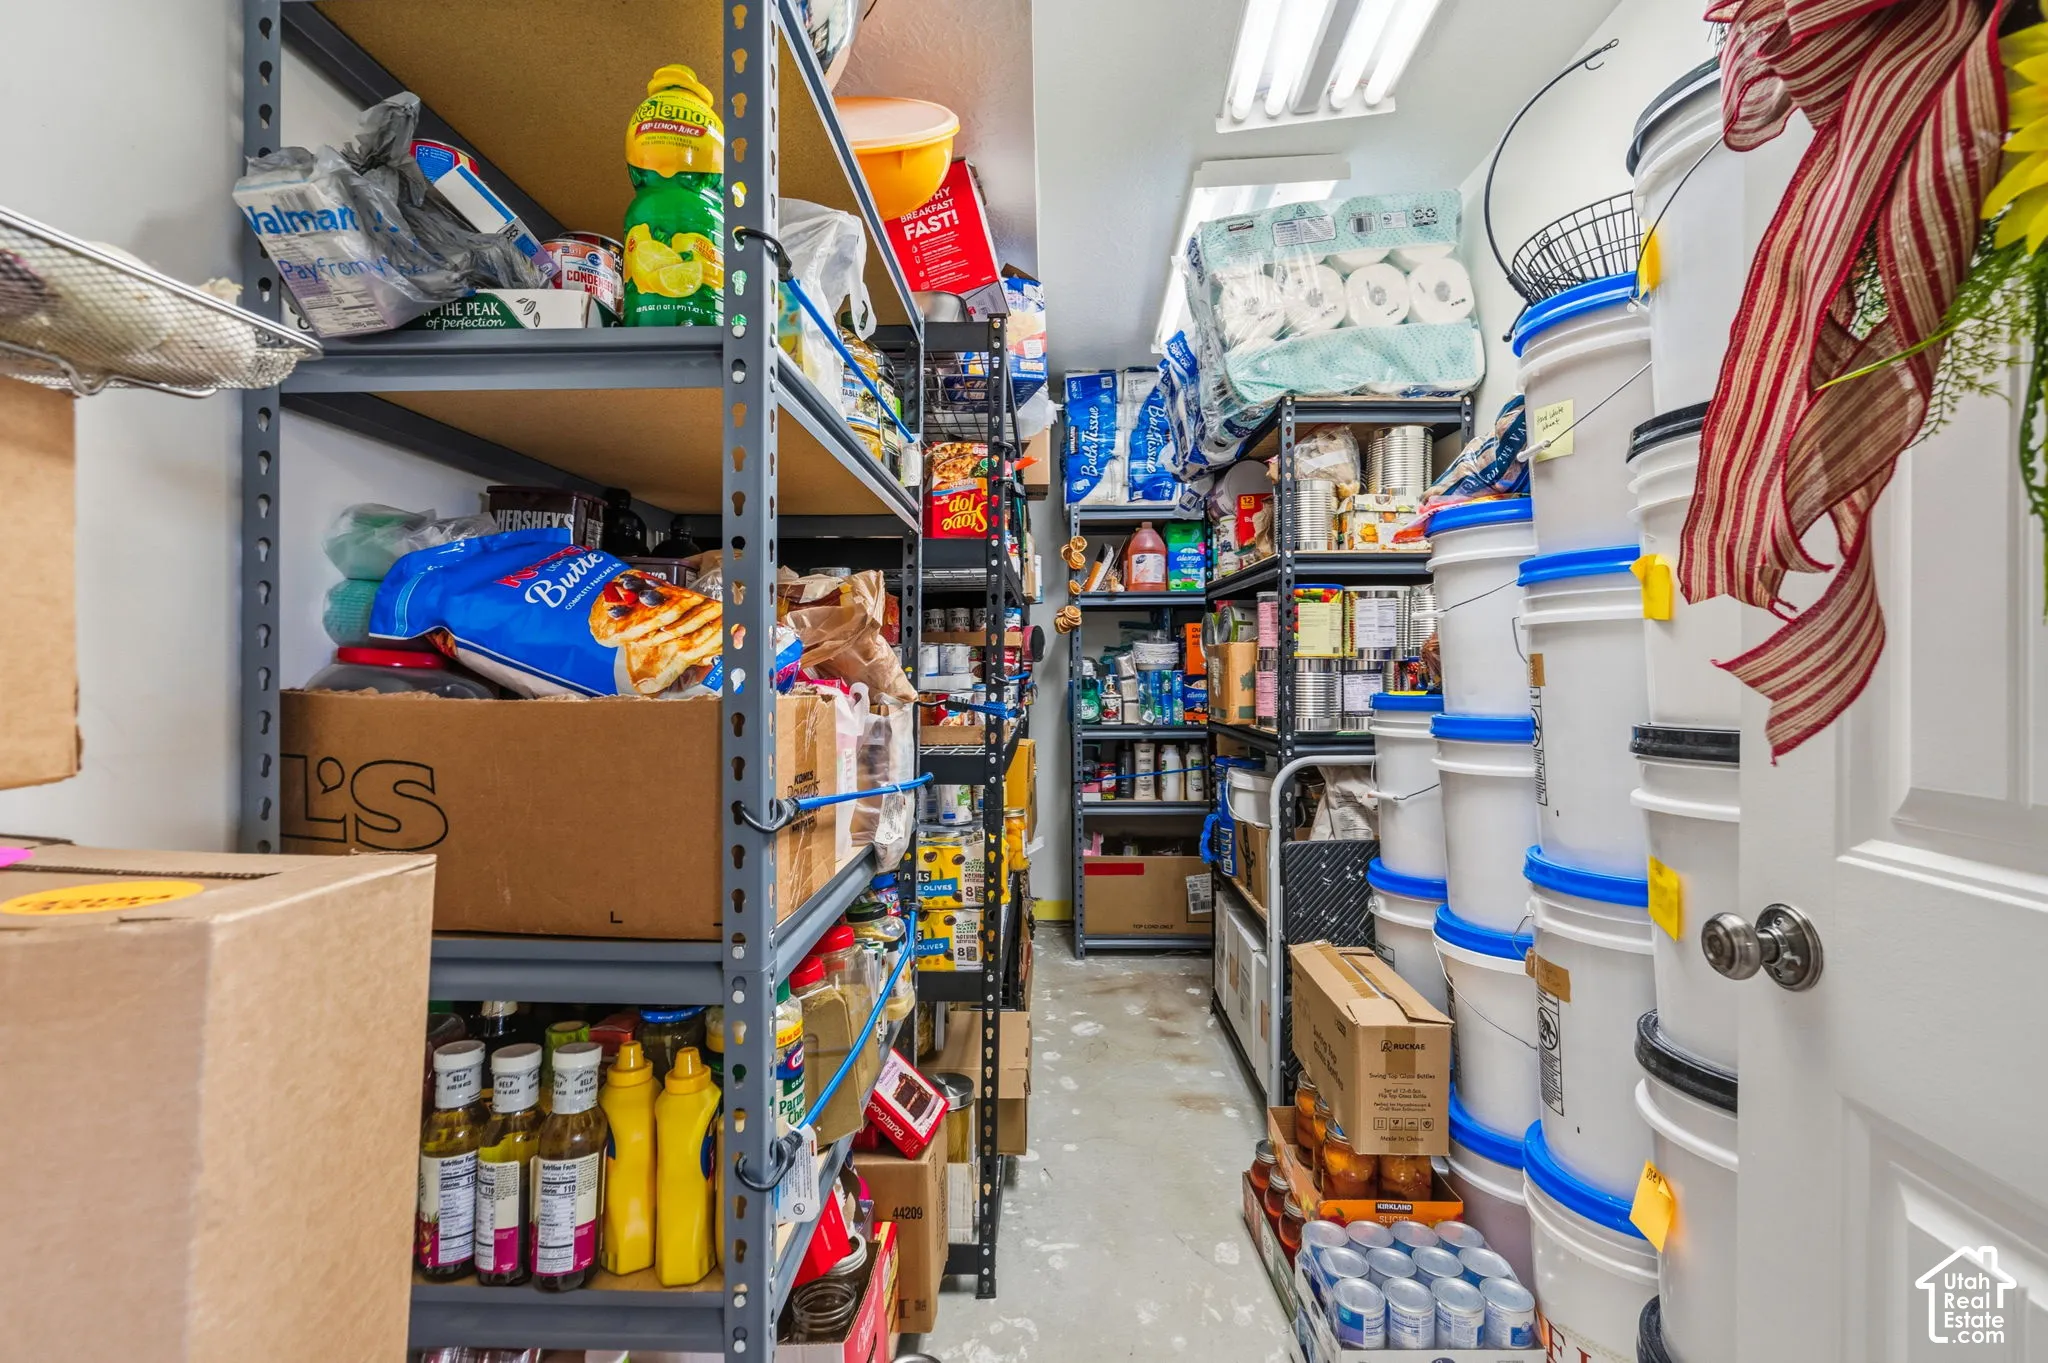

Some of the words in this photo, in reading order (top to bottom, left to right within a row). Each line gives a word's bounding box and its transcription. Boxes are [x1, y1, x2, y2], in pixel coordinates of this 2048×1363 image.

[654, 122, 677, 131] LEMON
[679, 125, 700, 136] JUICE
[900, 199, 954, 223] BREAKFAST
[903, 209, 960, 241] FAST!
[277, 259, 319, 284] Pay
[566, 269, 614, 294] CONDENSED
[466, 302, 501, 316] PEAK
[425, 316, 440, 330] of
[442, 316, 506, 331] perfection
[1082, 405, 1099, 444] Tissue
[1081, 442, 1099, 477] Bath
[497, 509, 574, 533] HERSHEY'S
[922, 883, 953, 892] OLIVES
[966, 886, 974, 897] 8
[917, 942, 944, 951] OLIVES
[957, 947, 965, 957] 8
[1393, 1043, 1425, 1051] RUCKAE
[563, 1184, 577, 1193] 110
[893, 1206, 924, 1220] 44209
[1377, 1203, 1412, 1211] KIRKLAND
